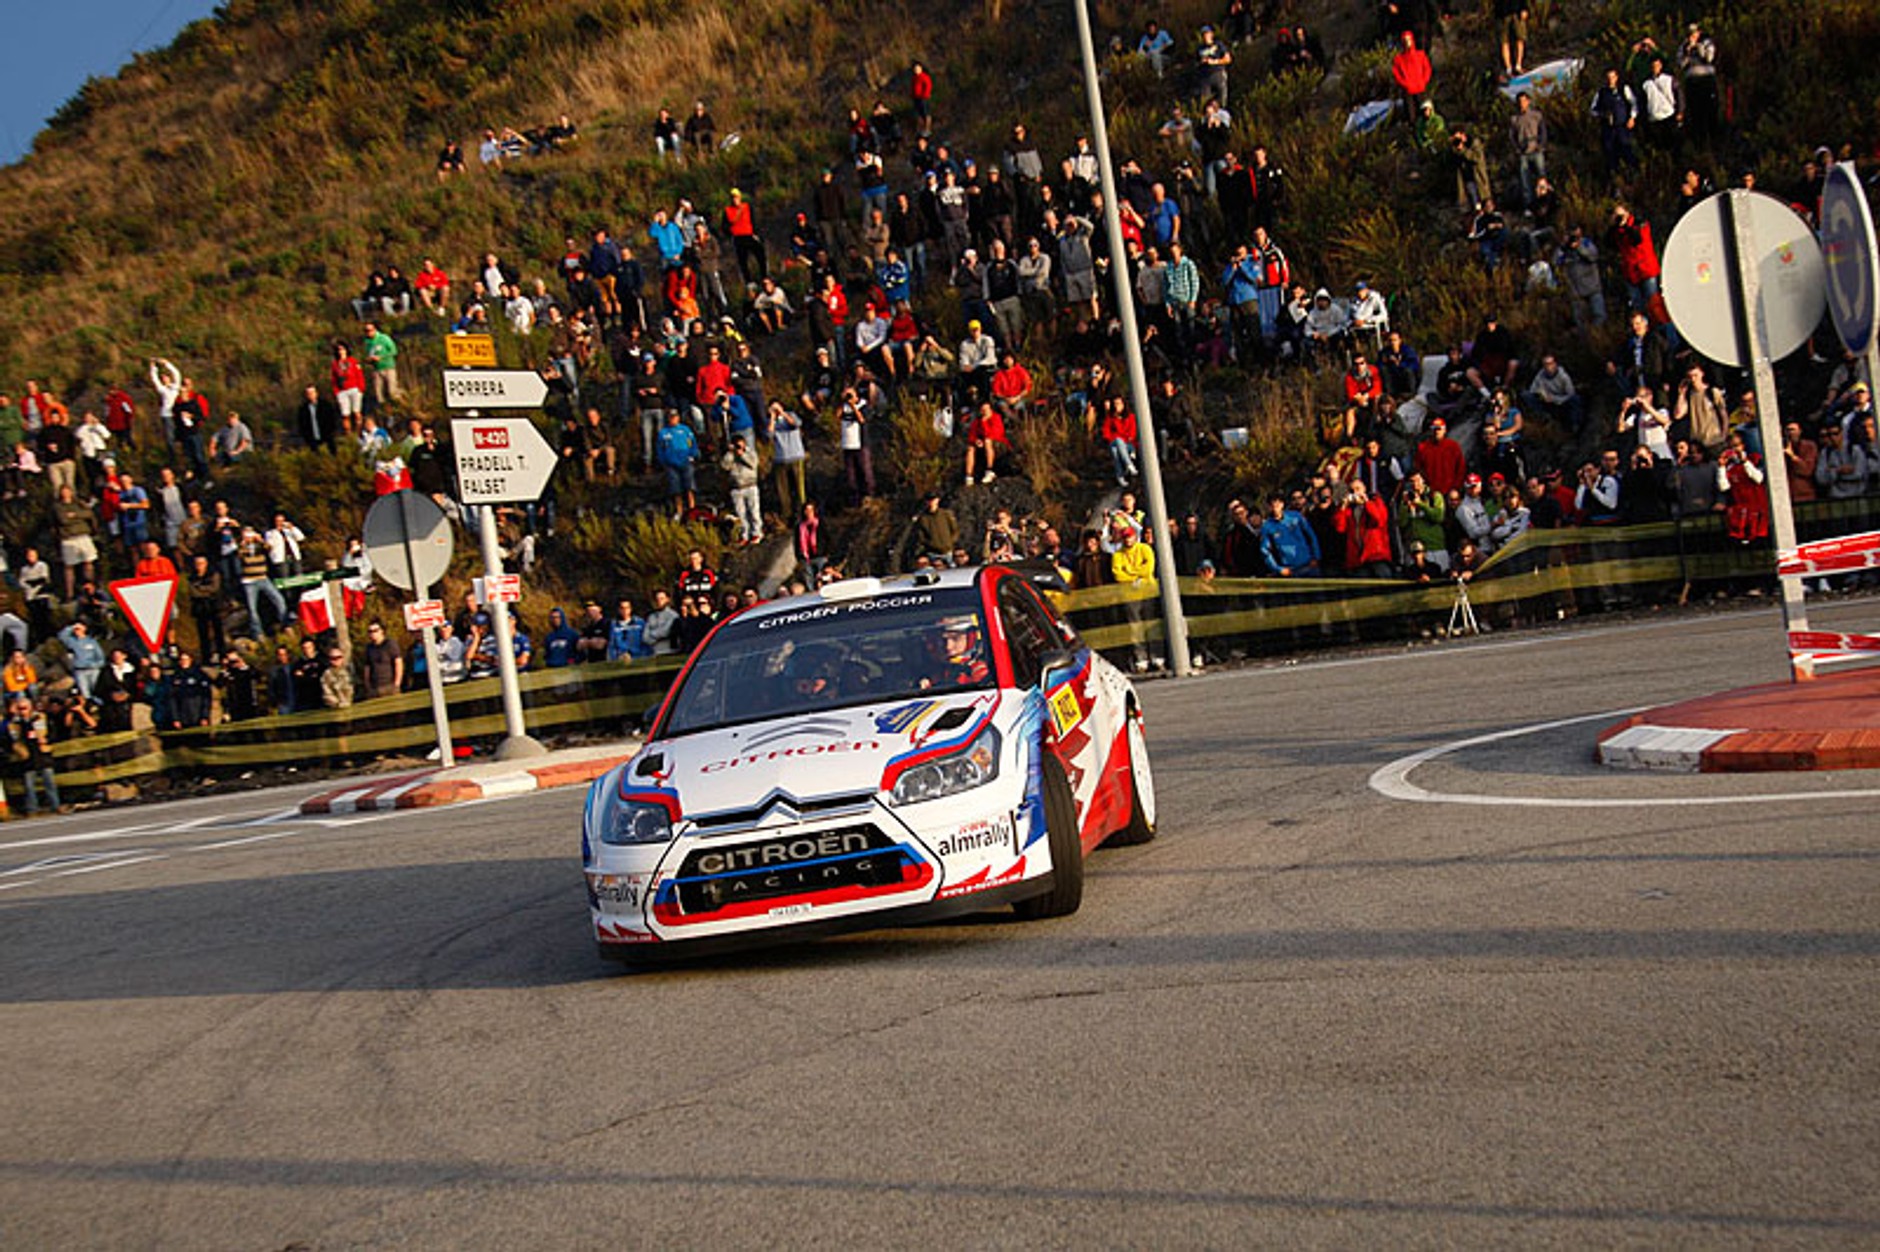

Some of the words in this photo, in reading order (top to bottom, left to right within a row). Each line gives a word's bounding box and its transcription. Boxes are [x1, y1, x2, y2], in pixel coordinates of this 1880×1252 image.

[449, 380, 505, 397] PORRERA
[474, 432, 507, 446] N-420
[461, 455, 513, 472] PRADELL
[463, 478, 506, 495] FALSET
[700, 740, 880, 773] CITROËN
[938, 824, 1010, 856] almrally
[698, 832, 868, 874] CITROËN
[702, 859, 873, 894] RACING
